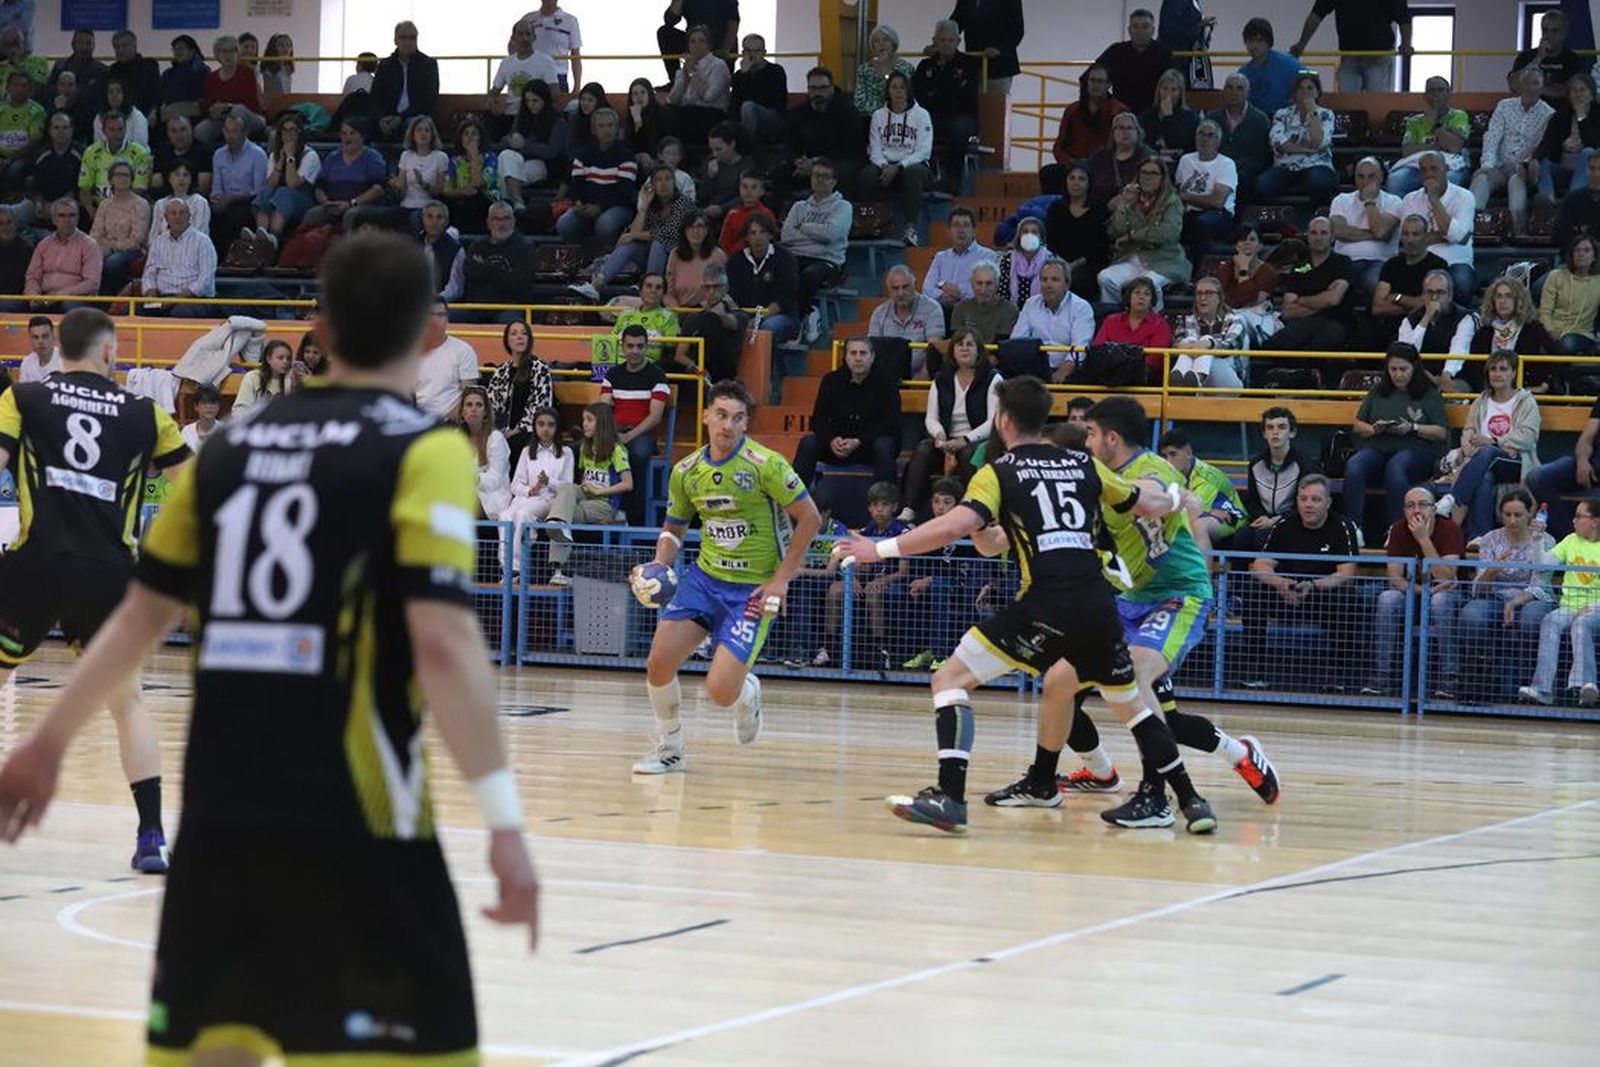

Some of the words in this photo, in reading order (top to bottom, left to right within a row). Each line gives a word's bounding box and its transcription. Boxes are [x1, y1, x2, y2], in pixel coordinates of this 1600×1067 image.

[51, 392, 118, 417] AGORRETA
[60, 382, 125, 404] UCLM
[63, 412, 102, 471] 8
[248, 421, 360, 448] UCLM
[1025, 458, 1078, 468] UCLM
[1030, 480, 1086, 530] 15
[705, 524, 759, 540] AMORA
[209, 482, 319, 620] 18
